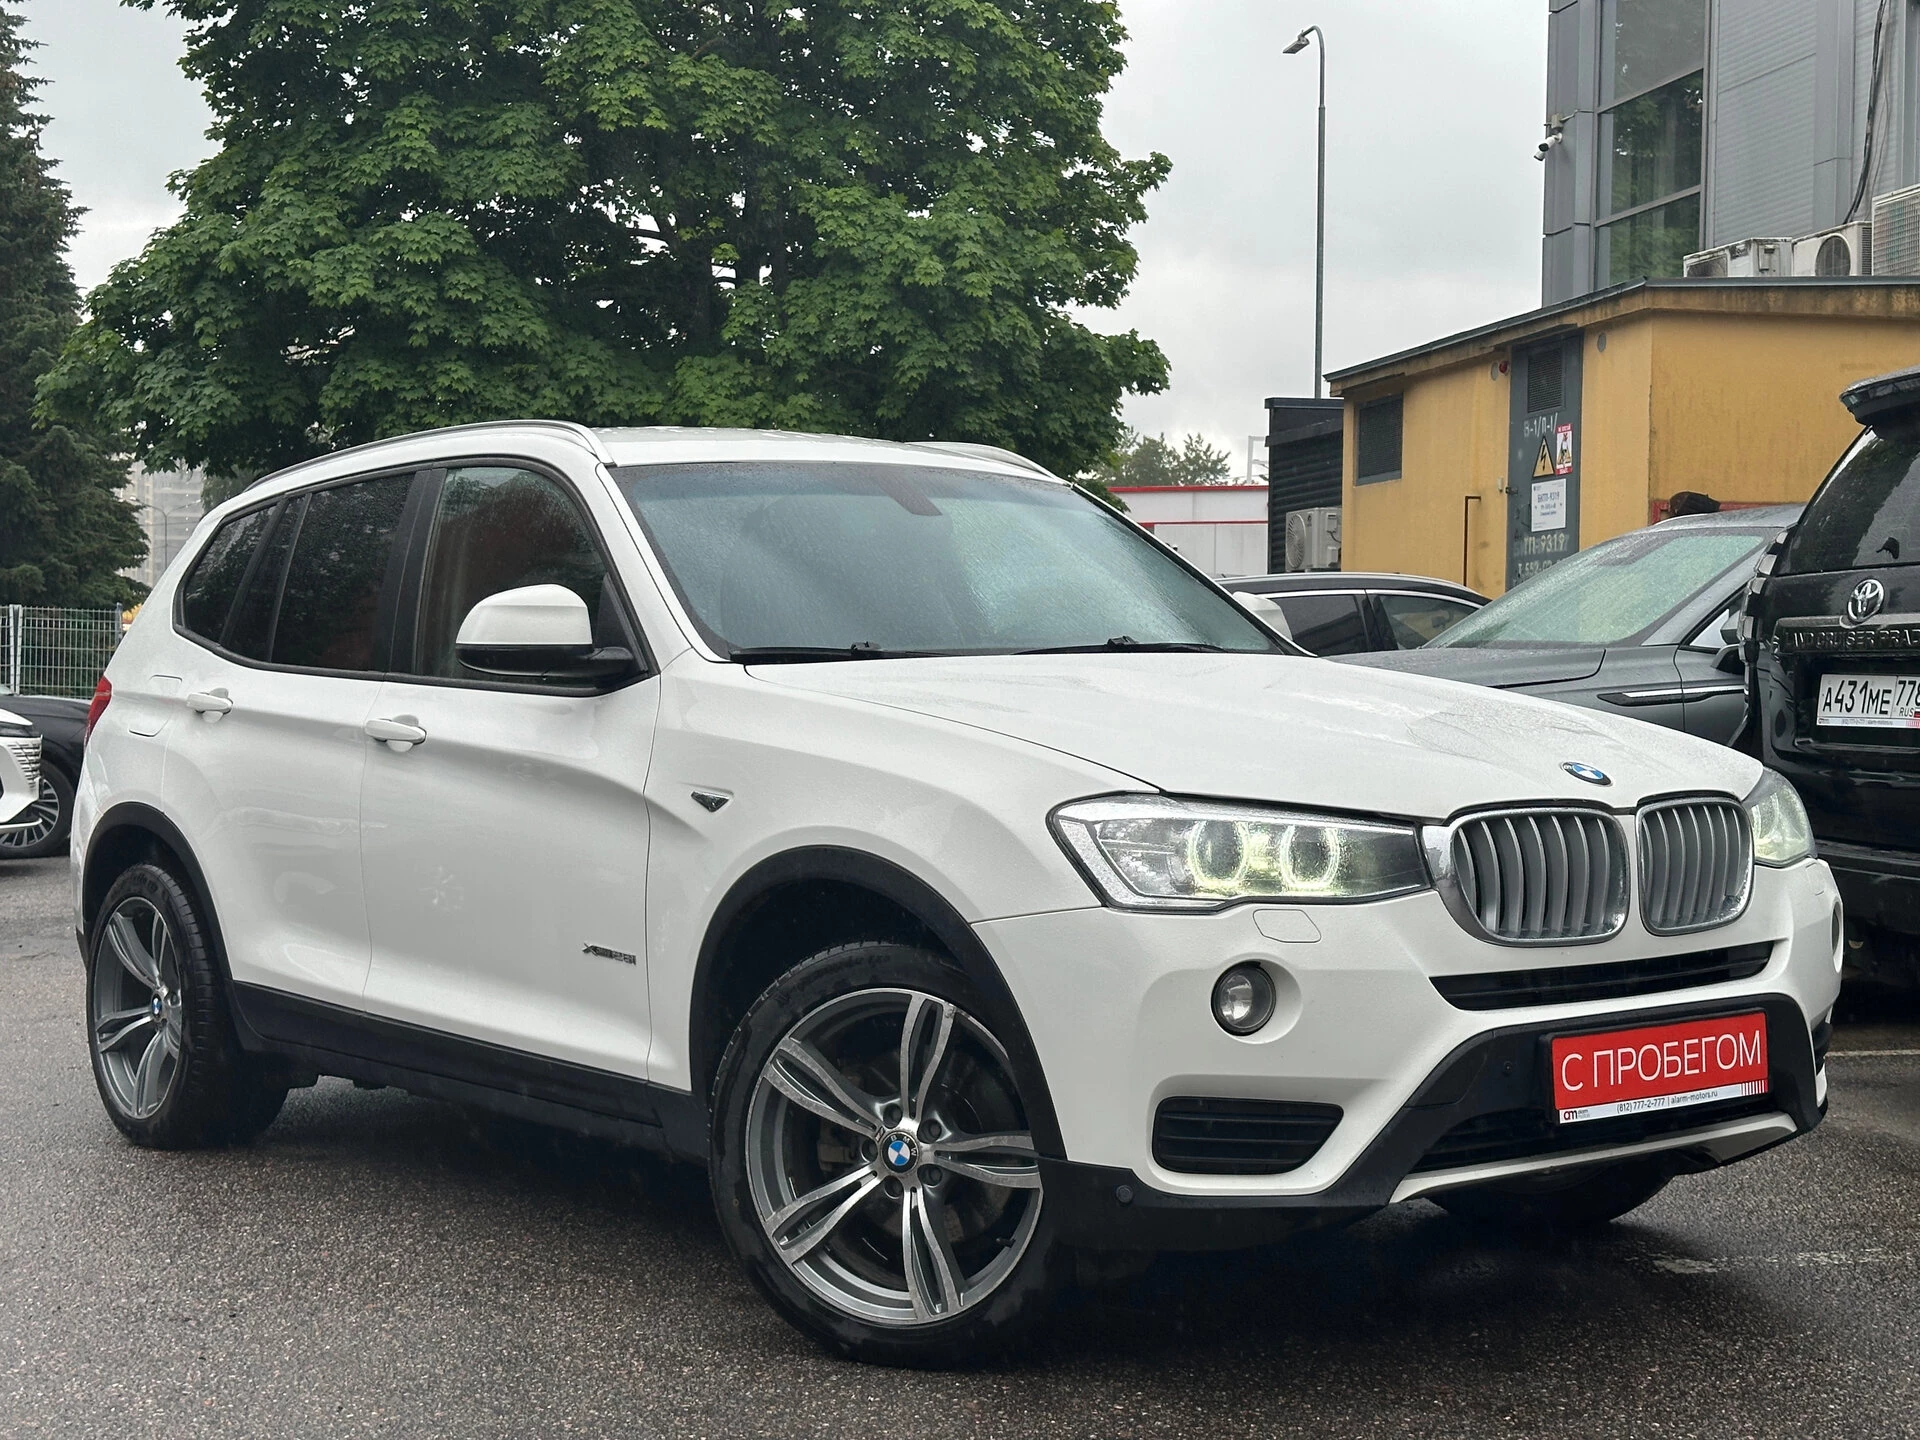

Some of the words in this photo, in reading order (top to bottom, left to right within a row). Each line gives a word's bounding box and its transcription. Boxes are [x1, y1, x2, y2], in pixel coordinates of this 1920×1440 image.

[1899, 707, 1914, 718] RUS
[1561, 1053, 1584, 1092] С
[1593, 1030, 1761, 1088] ПРОБЕГОМ
[1616, 1102, 1633, 1114] (812)
